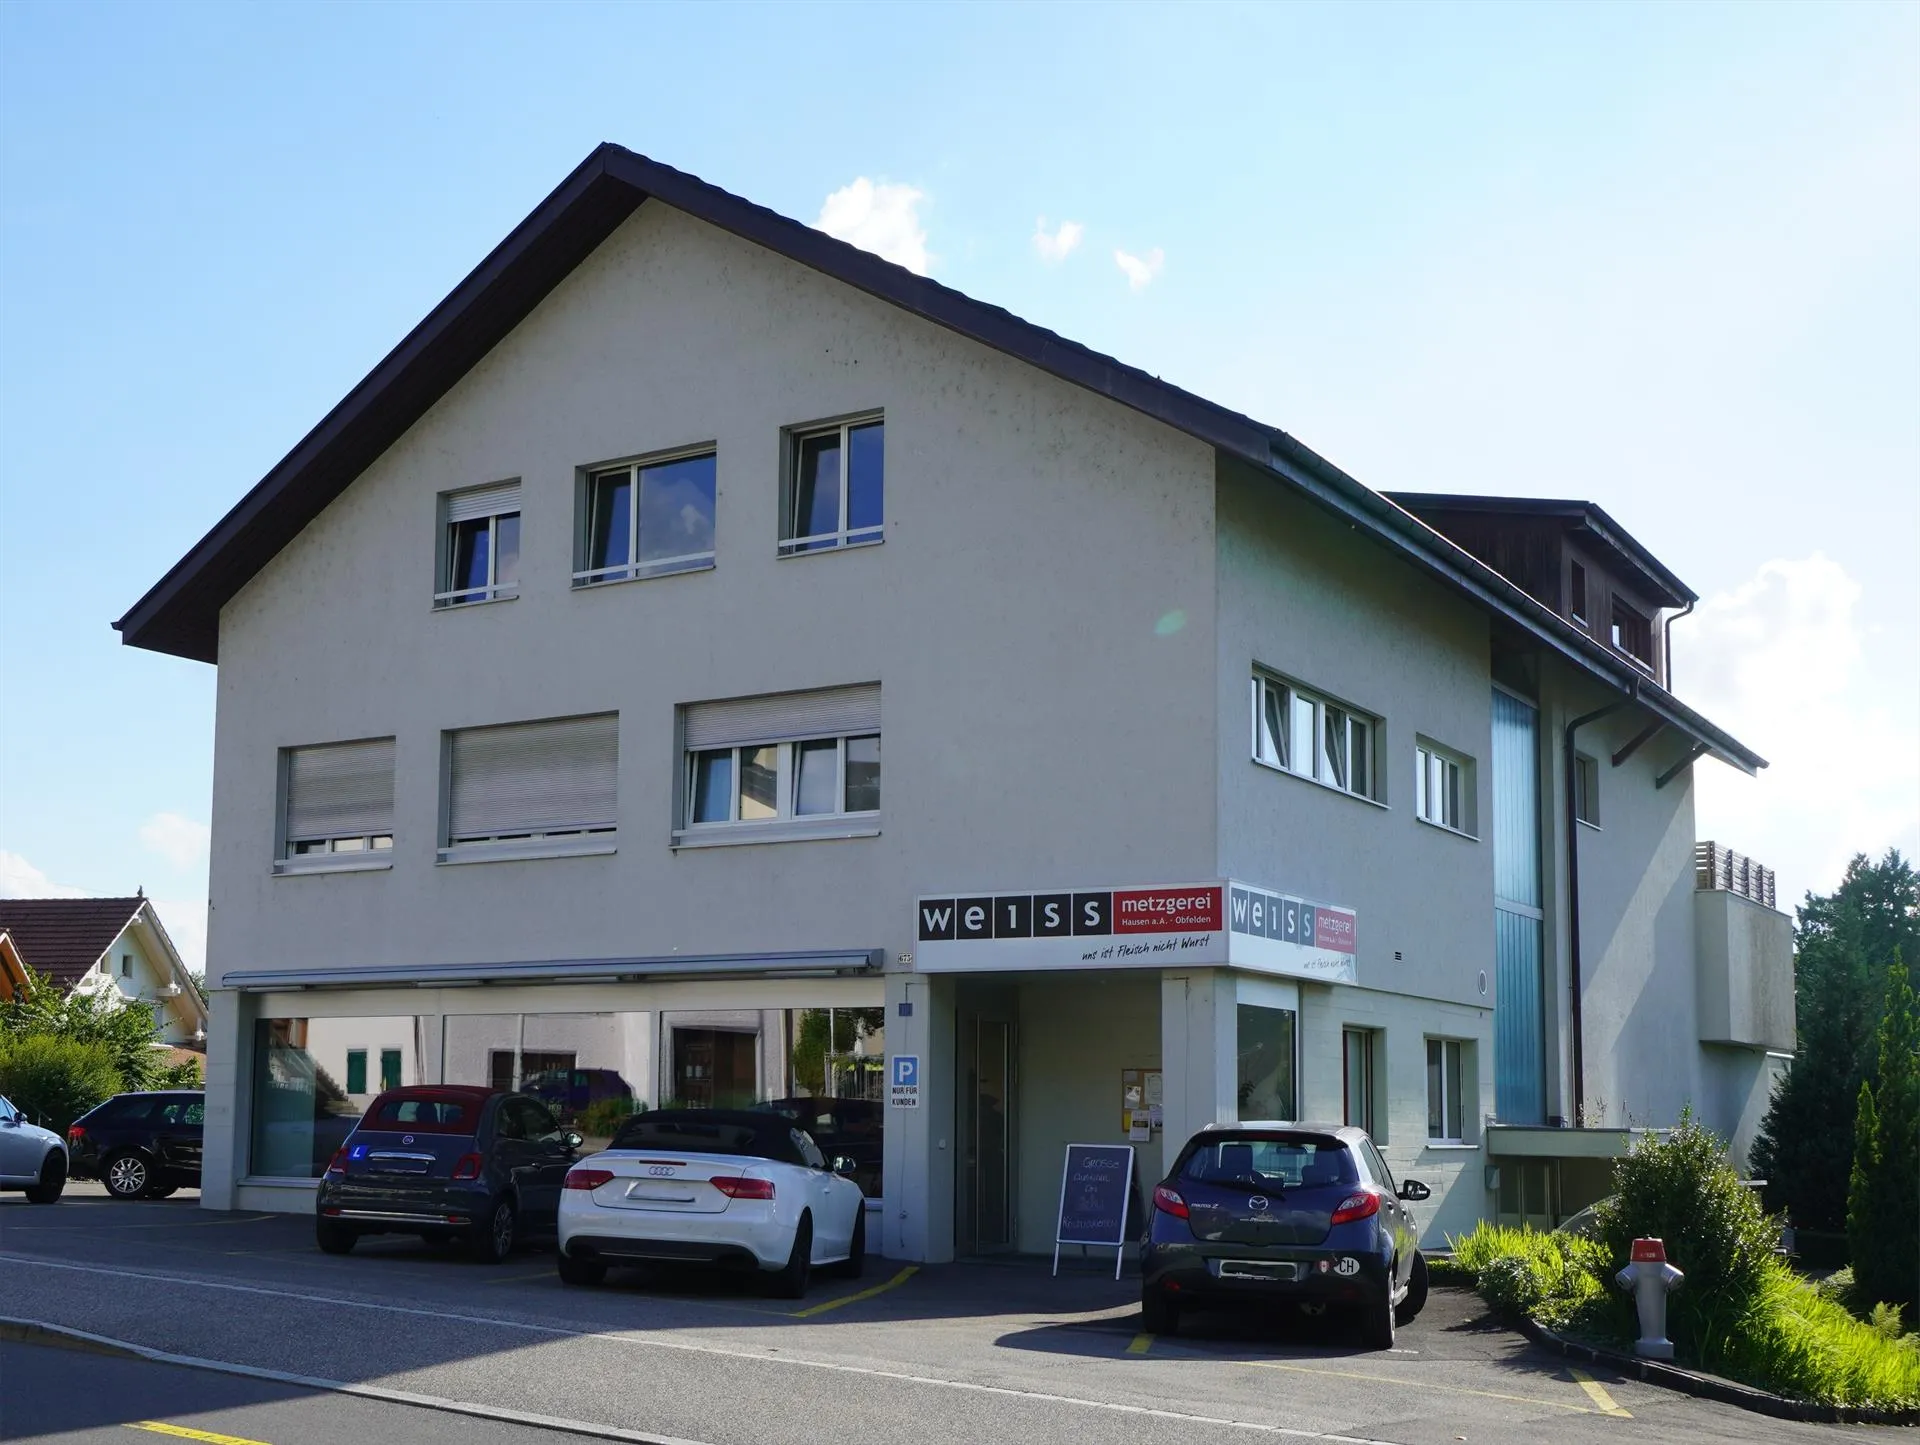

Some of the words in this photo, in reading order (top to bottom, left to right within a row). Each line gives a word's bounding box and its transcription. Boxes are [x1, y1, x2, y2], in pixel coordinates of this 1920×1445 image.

[1121, 893, 1211, 914] metzgerei
[1121, 918, 1150, 926] Hausen
[1175, 916, 1211, 924] Obfelden
[1318, 916, 1352, 935] metzgerei
[1082, 950, 1098, 960] uns
[1101, 946, 1114, 959] ist
[1117, 942, 1149, 957] Fleisch
[1152, 938, 1178, 952] nicht
[1181, 933, 1210, 949] Wurst
[1340, 1260, 1354, 1273] CH
